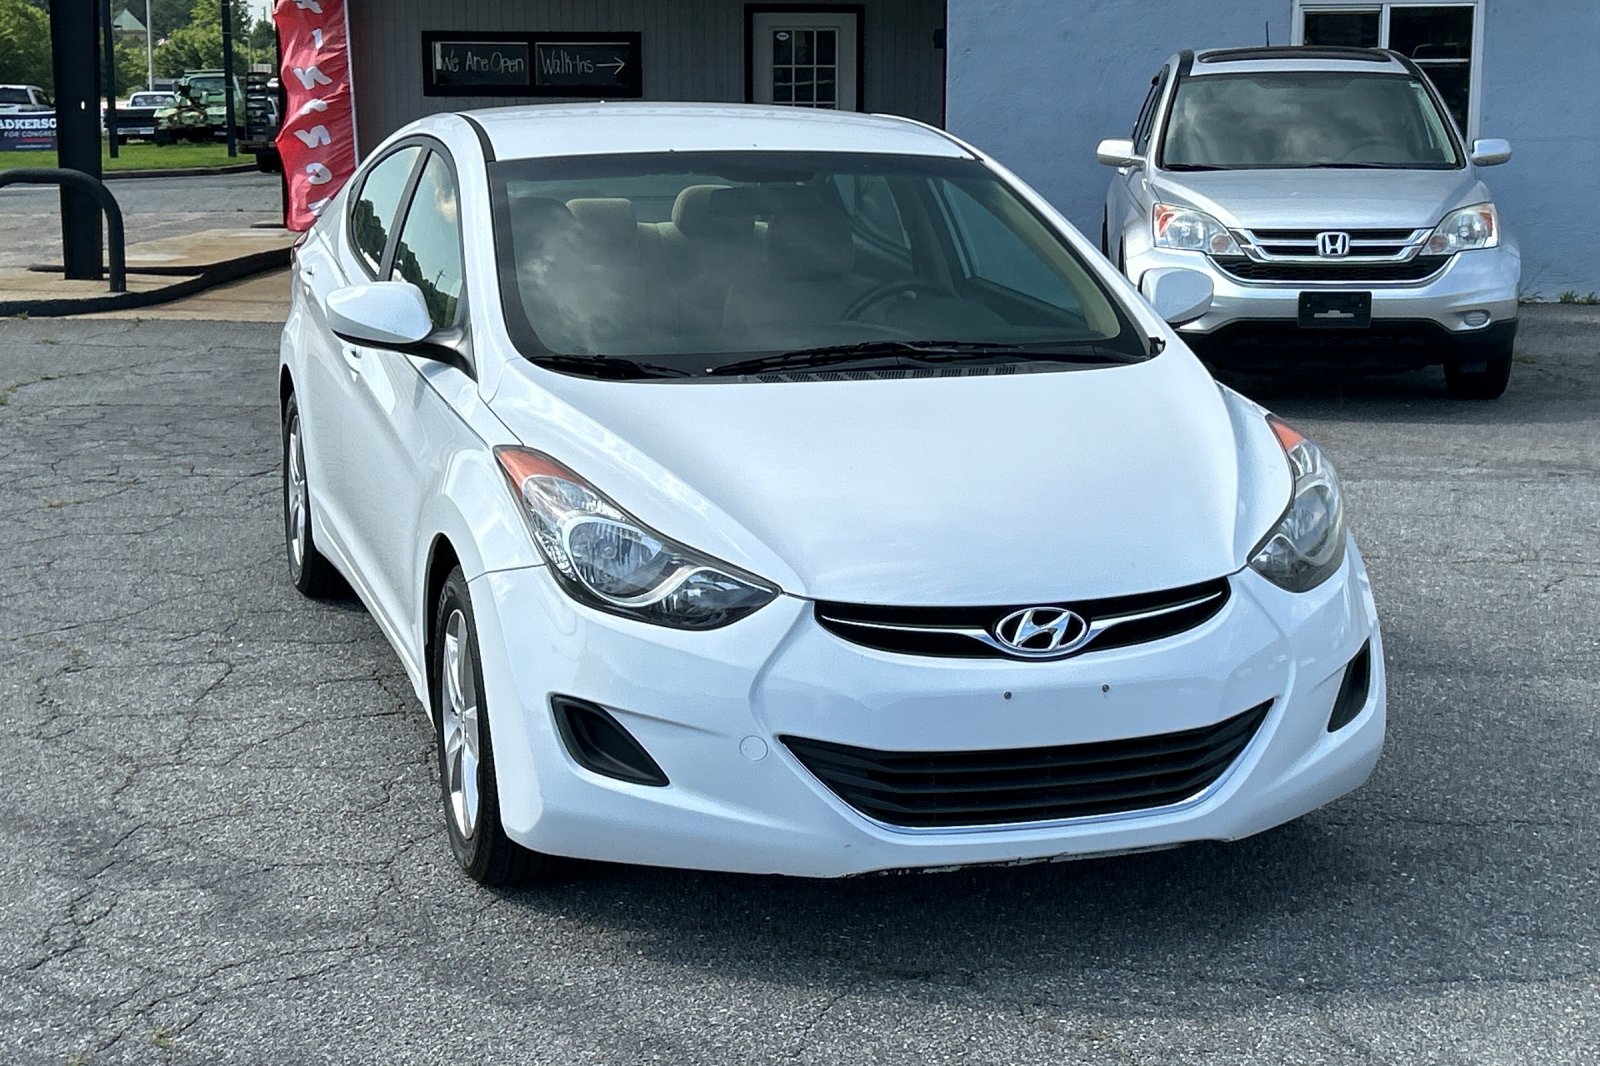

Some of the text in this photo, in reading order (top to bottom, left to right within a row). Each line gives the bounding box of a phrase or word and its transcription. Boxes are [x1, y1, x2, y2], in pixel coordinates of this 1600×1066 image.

[441, 49, 525, 73] We Are Open
